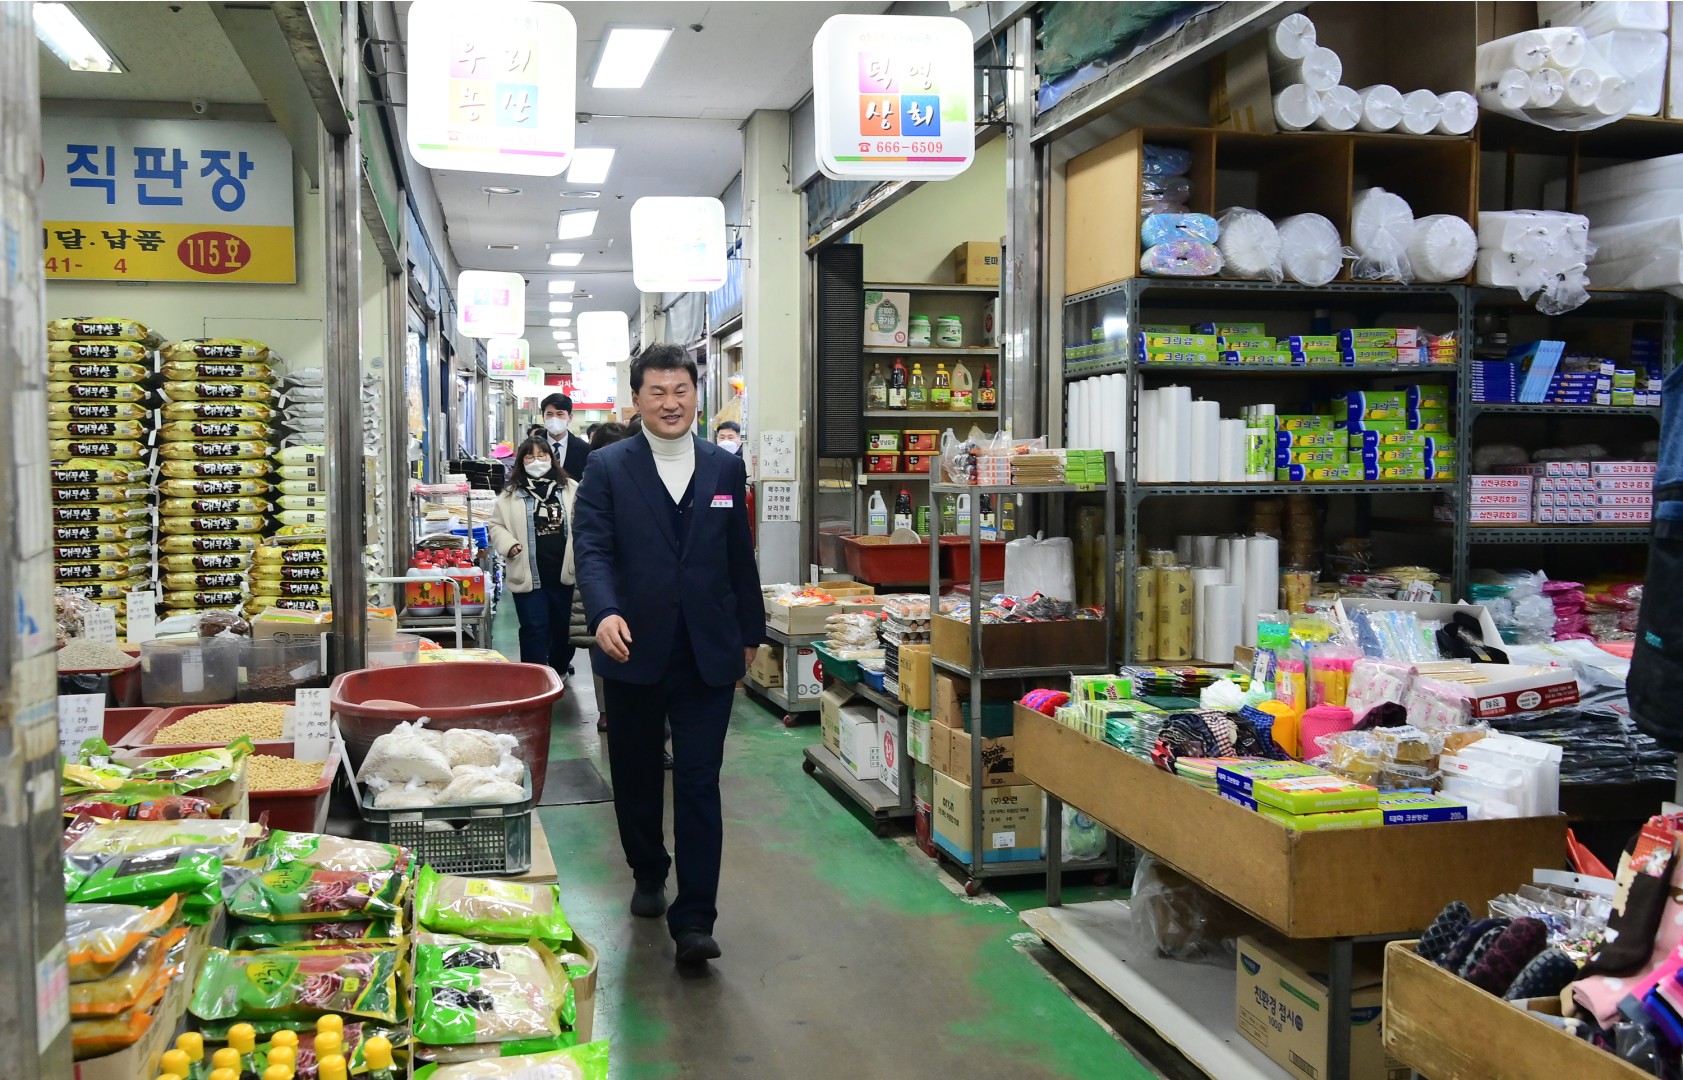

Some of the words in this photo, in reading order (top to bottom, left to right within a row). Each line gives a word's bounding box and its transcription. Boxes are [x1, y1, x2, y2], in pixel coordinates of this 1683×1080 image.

[865, 100, 935, 130] 상회
[876, 142, 943, 153] 666-6509
[66, 144, 254, 212] 직판장
[187, 238, 242, 269] 115호
[1254, 985, 1277, 1017] 친환경
[1279, 1002, 1295, 1026] 접시
